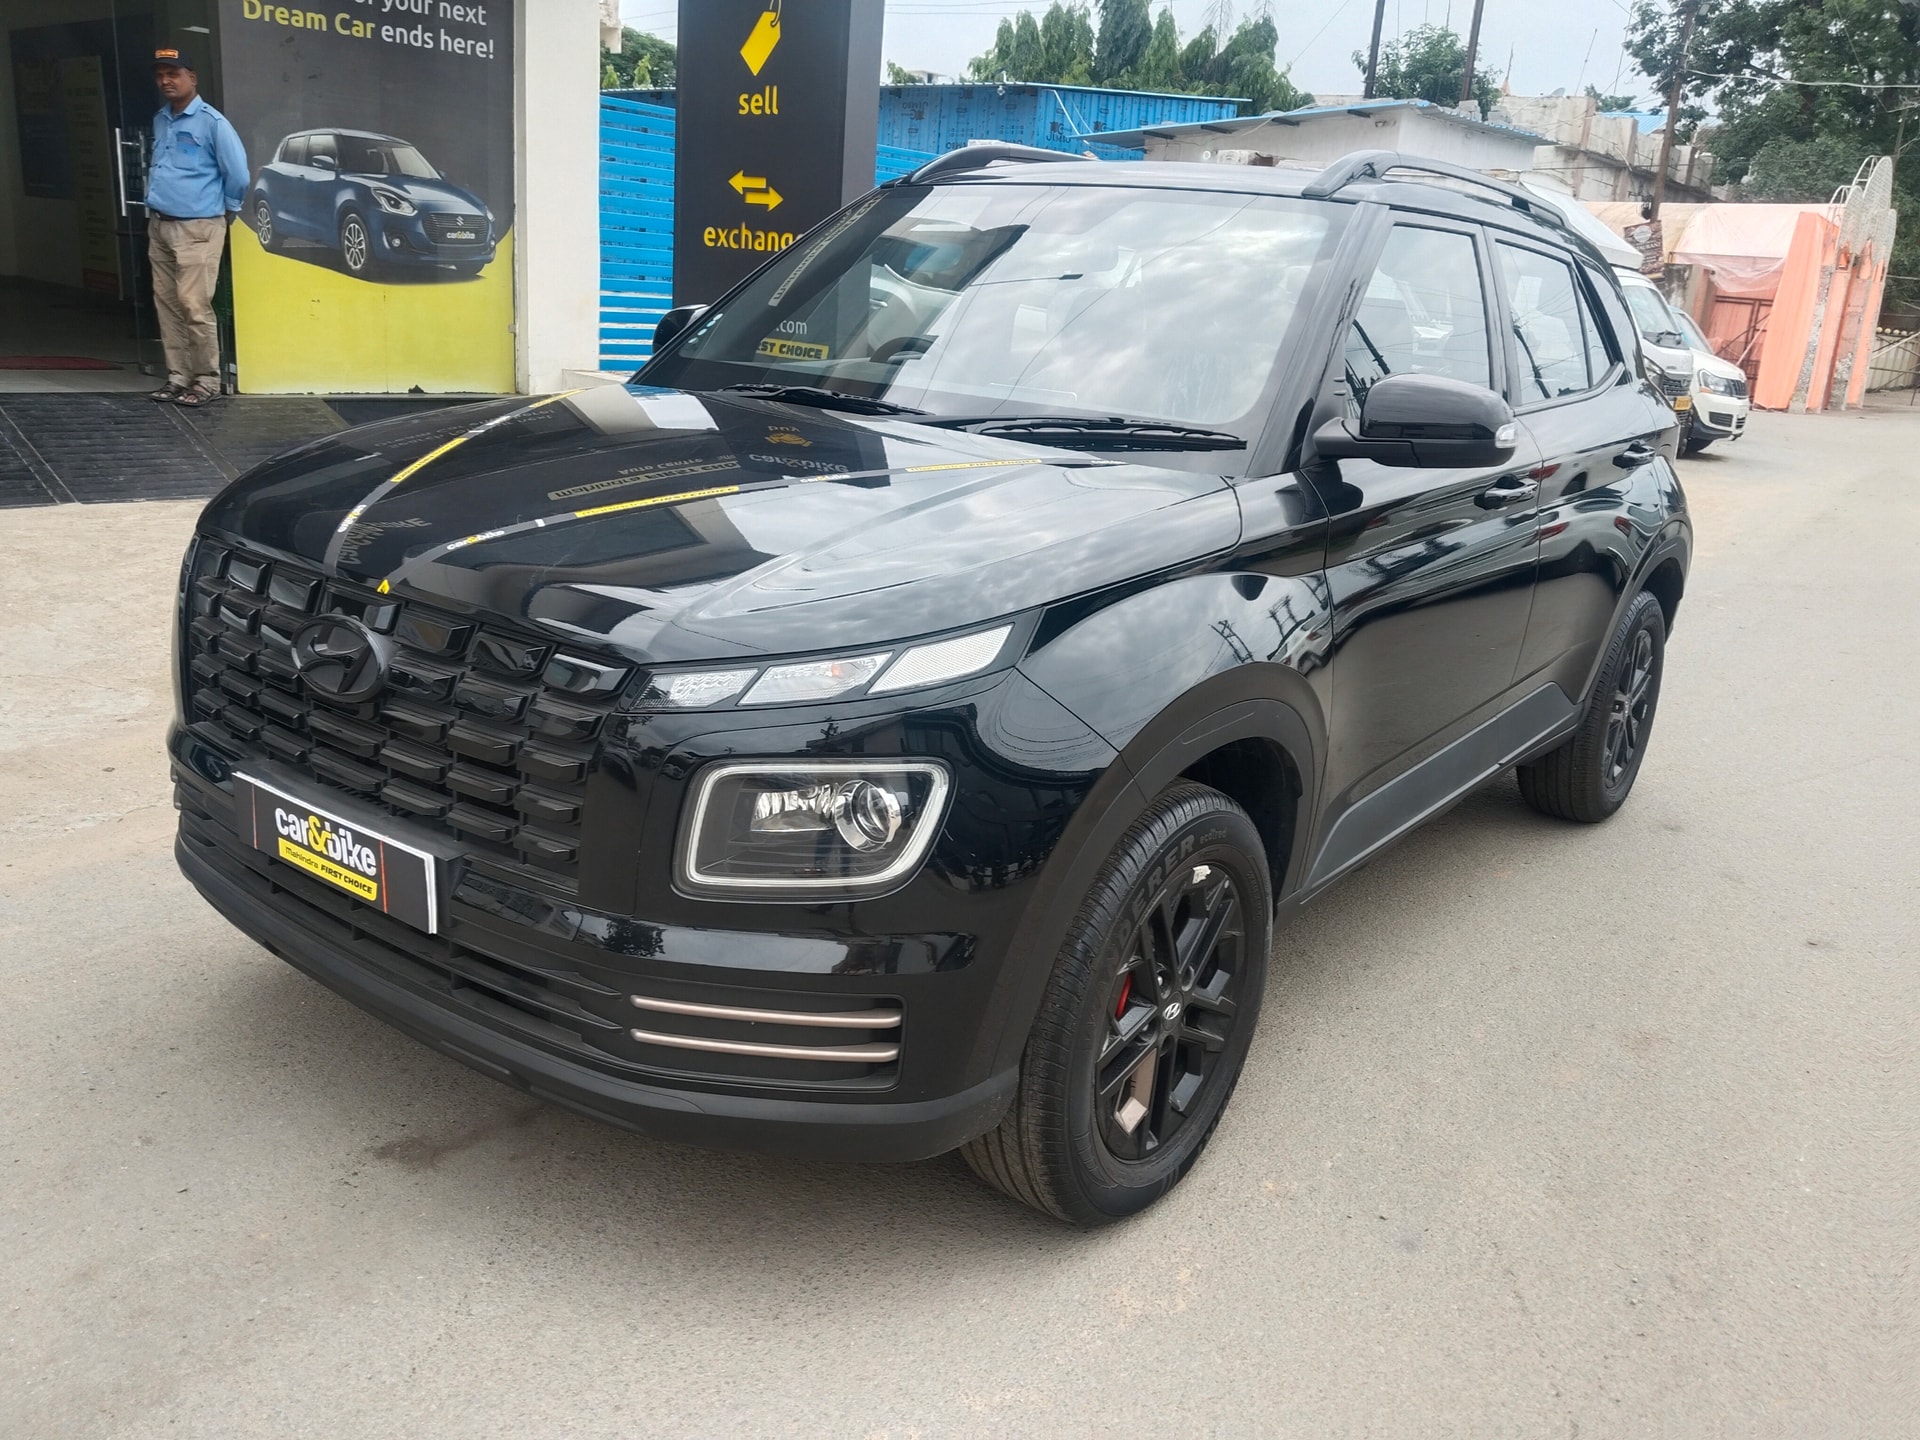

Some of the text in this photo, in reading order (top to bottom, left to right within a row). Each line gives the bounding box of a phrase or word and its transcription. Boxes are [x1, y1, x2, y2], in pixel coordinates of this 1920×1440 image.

[439, 1, 487, 25] next
[243, 0, 494, 59] Dream Car ends here!
[738, 85, 779, 115] sell
[704, 221, 804, 252] exchang
[779, 343, 824, 360] CHOICE
[275, 807, 377, 877] car&bike
[320, 864, 343, 881] FIRST
[343, 875, 373, 894] CHOICE
